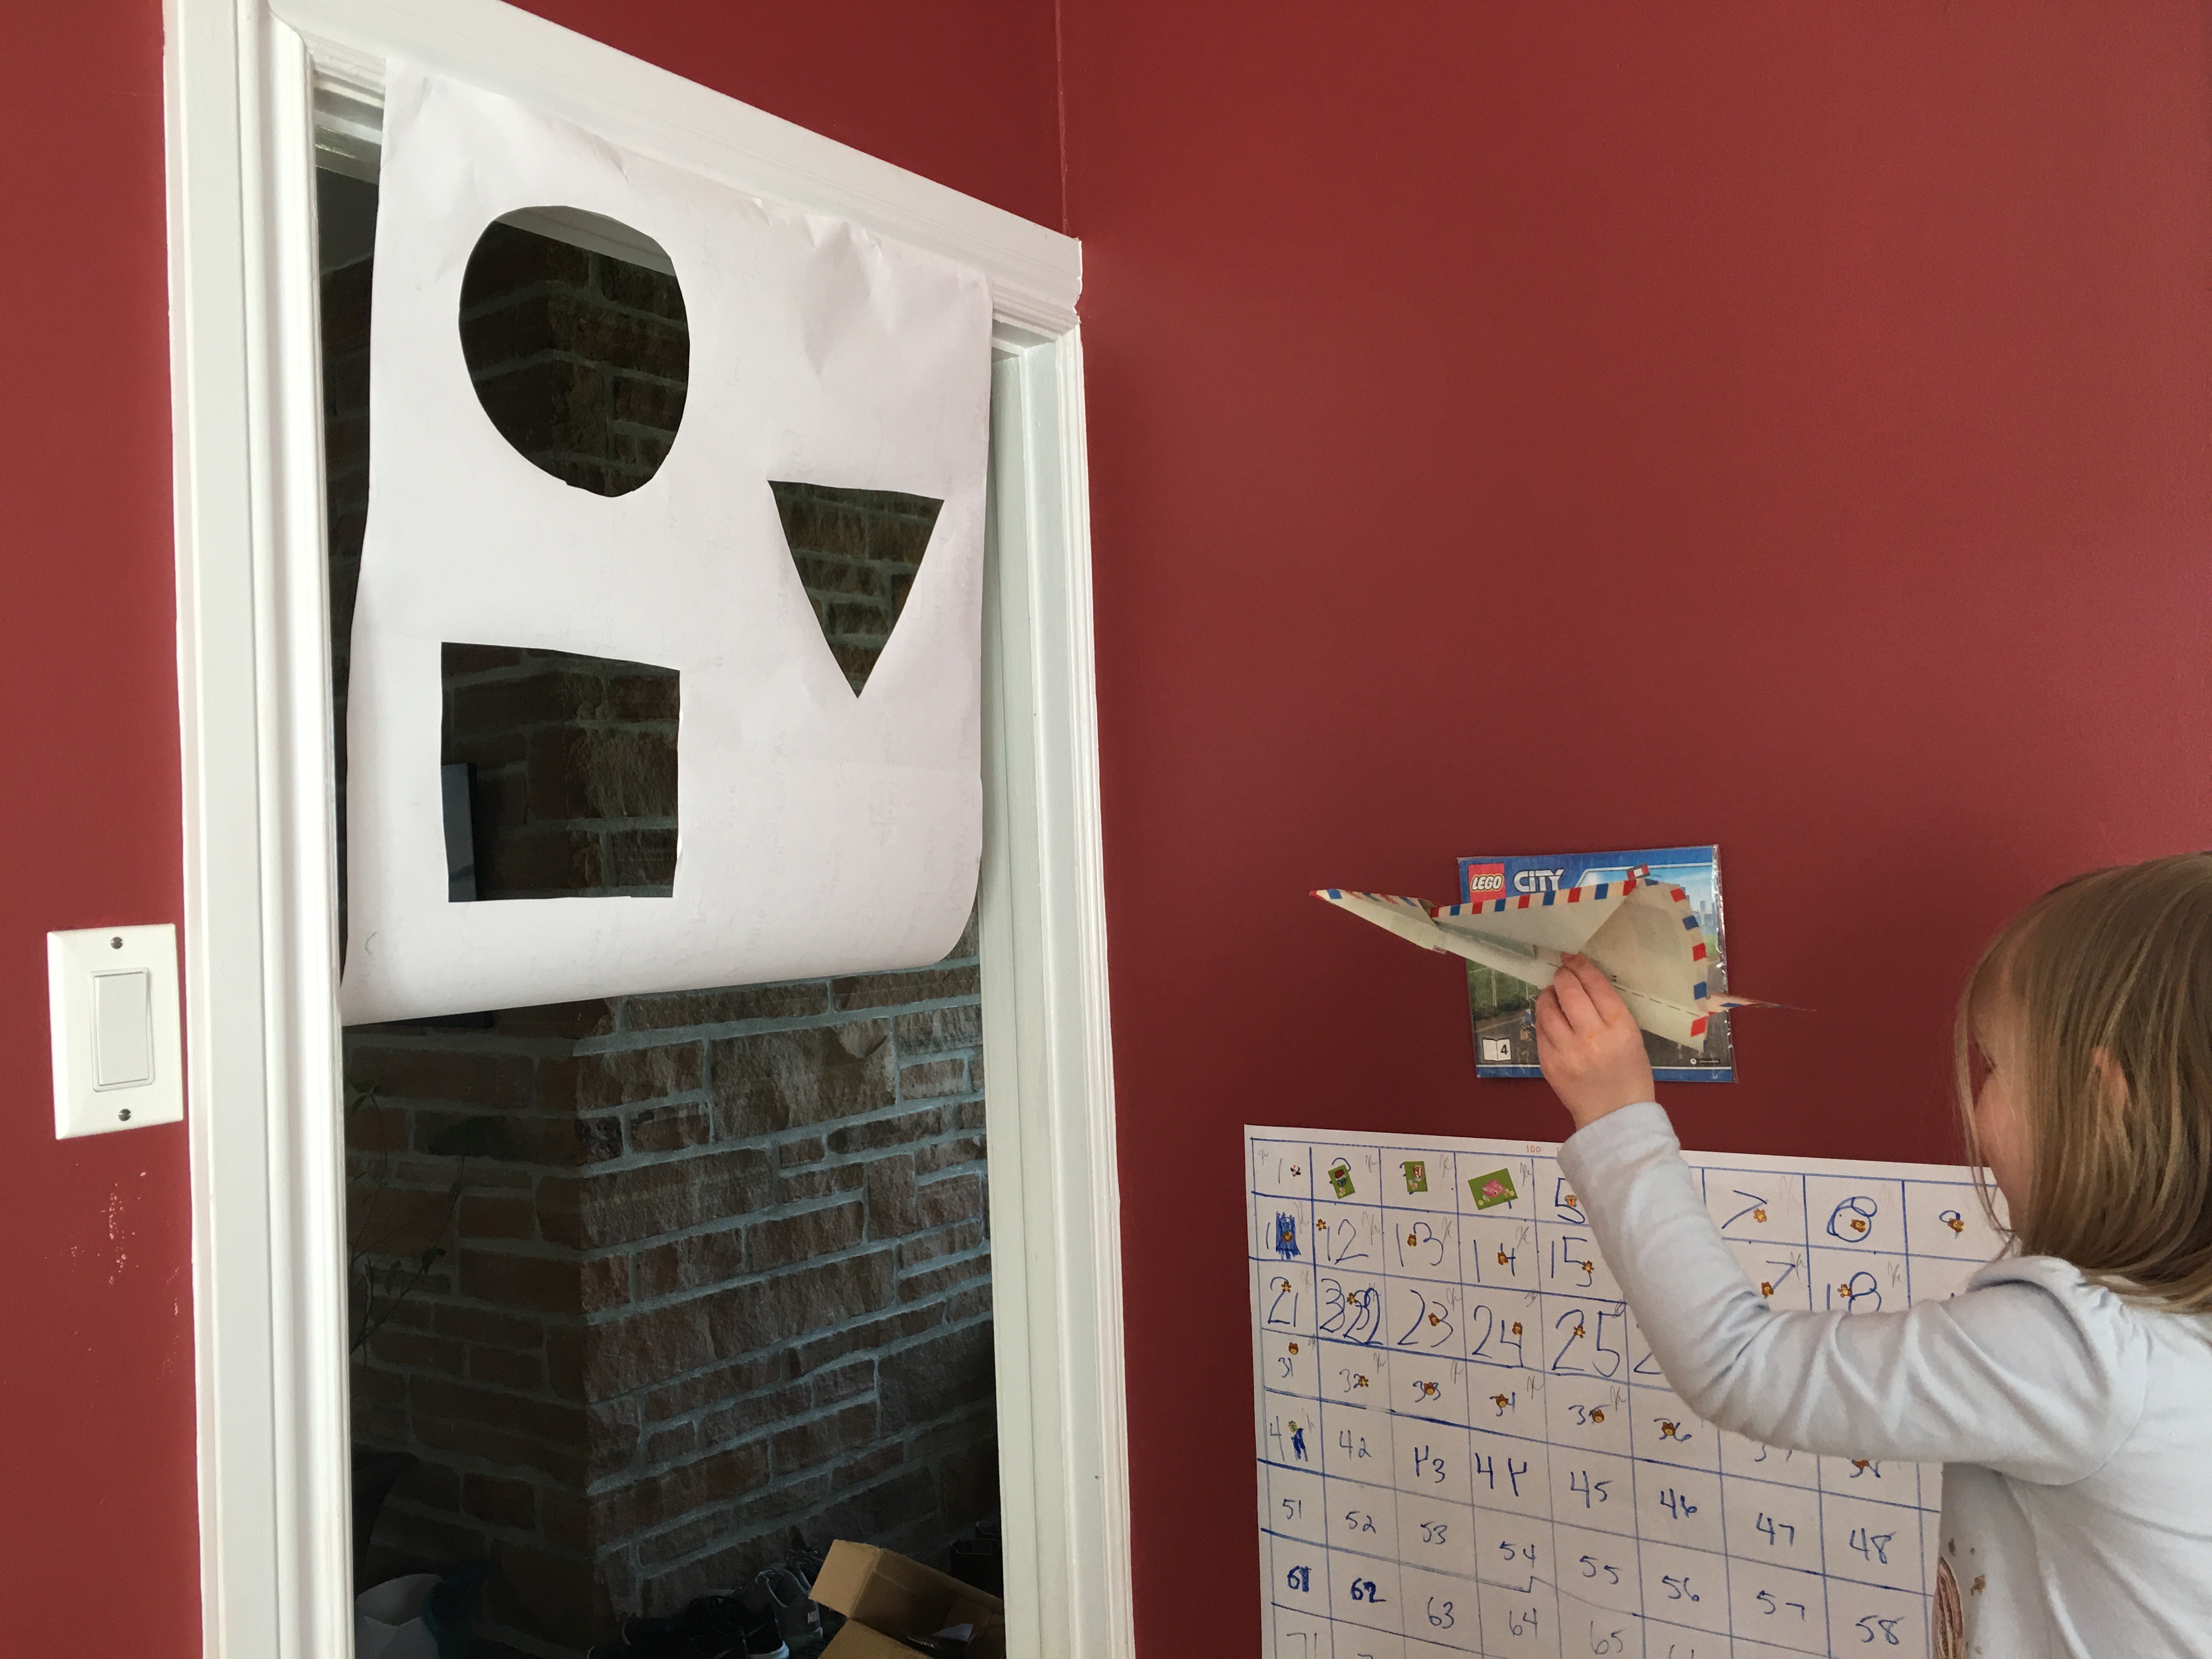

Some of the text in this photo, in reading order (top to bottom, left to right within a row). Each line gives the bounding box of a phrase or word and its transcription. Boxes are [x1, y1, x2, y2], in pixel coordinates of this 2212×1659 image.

[1471, 874, 1503, 891] LEGO
[1500, 1044, 1508, 1054] 4
[1526, 1144, 1542, 1153] 100
[1555, 1177, 1585, 1224] 5
[1327, 1218, 1368, 1265] 12
[1396, 1222, 1444, 1267] 13
[1473, 1240, 1516, 1282] 14
[1551, 1235, 1592, 1286] 15
[1267, 1277, 1299, 1327] 21
[1397, 1289, 1454, 1347] 23
[1472, 1305, 1523, 1367] 24
[1551, 1309, 1621, 1377] 25
[1278, 1357, 1294, 1378] 31
[1413, 1380, 1441, 1402] 33
[1339, 1430, 1372, 1457] 42
[1571, 1471, 1612, 1508] 45
[1660, 1488, 1698, 1519] 46
[1756, 1513, 1795, 1546] 47
[1849, 1527, 1897, 1564] 48
[1282, 1499, 1904, 1645] 51 52 53 54 55 56 57 58
[1351, 1578, 1386, 1604] 62
[1427, 1597, 1454, 1629] 63
[1509, 1608, 1537, 1636] 64
[1590, 1621, 1627, 1655] 65
